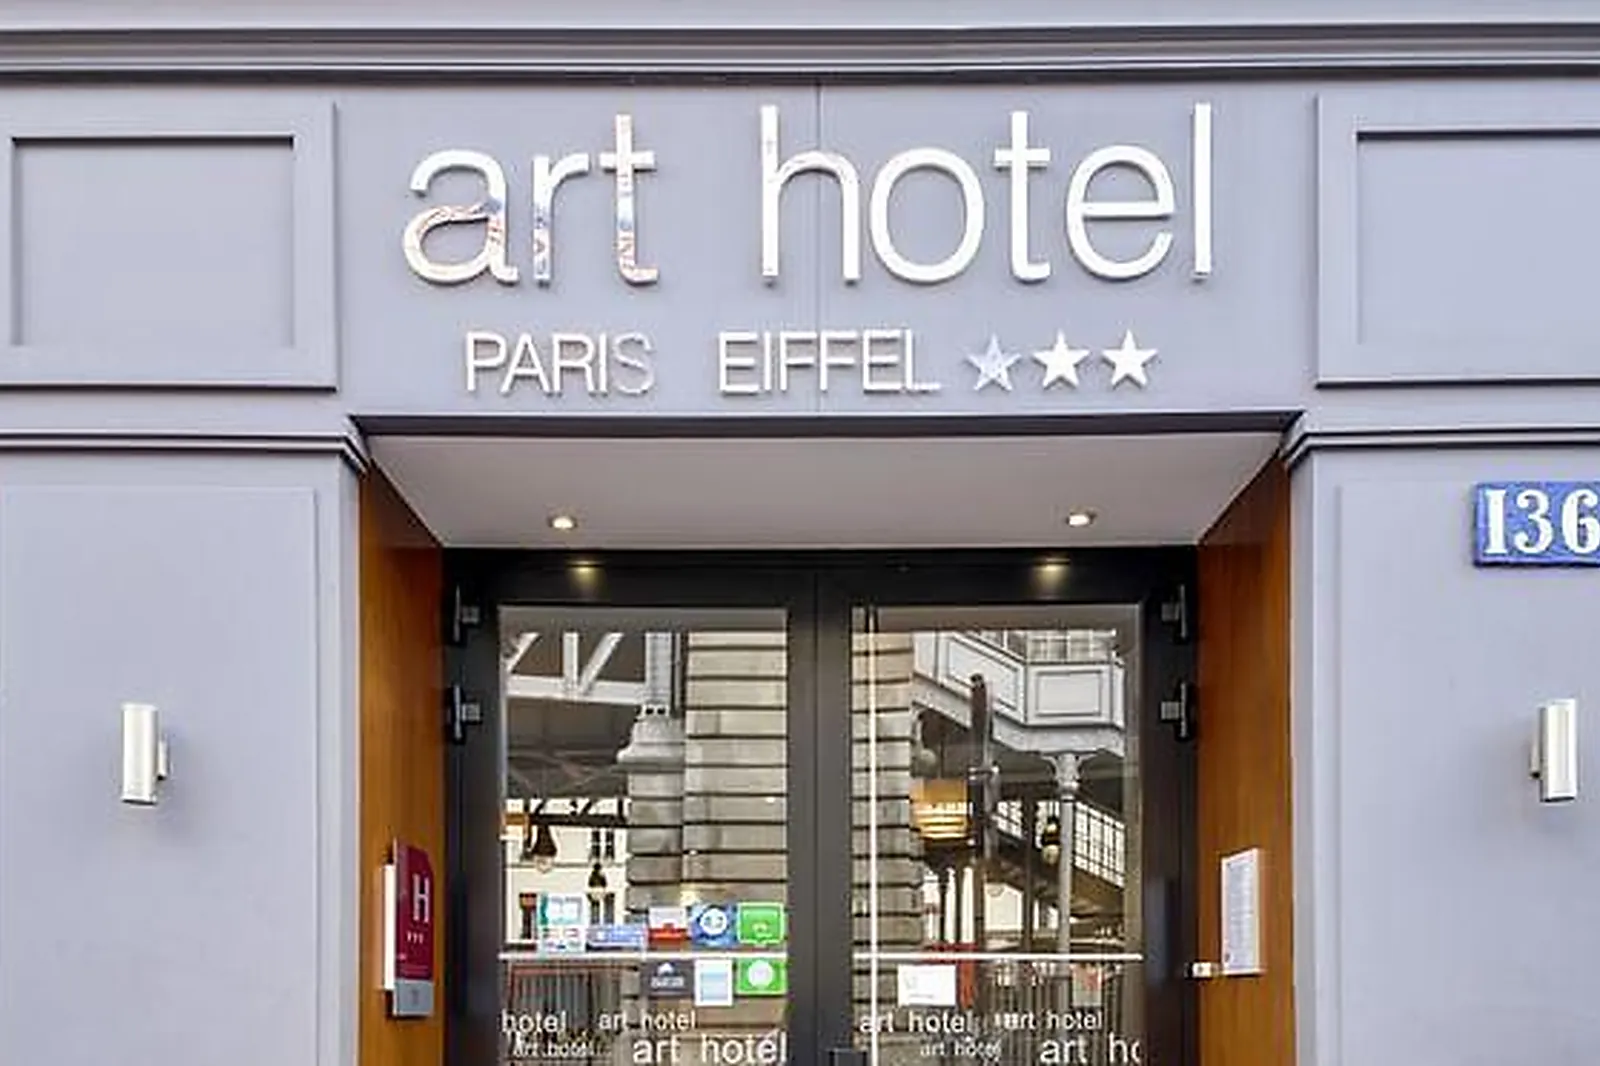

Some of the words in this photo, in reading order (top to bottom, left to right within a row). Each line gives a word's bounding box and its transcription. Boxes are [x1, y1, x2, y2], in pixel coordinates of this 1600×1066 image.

[403, 113, 658, 286] art
[760, 103, 1213, 286] hotel
[466, 330, 654, 396] PARIS
[719, 328, 941, 394] EIFFEL
[1484, 488, 1600, 554] 136
[412, 873, 431, 923] H
[641, 1009, 697, 1031] hotel
[908, 1010, 973, 1033] hotel
[632, 1034, 682, 1064] art
[701, 1031, 787, 1064] hotel
[1040, 1034, 1087, 1064] art
